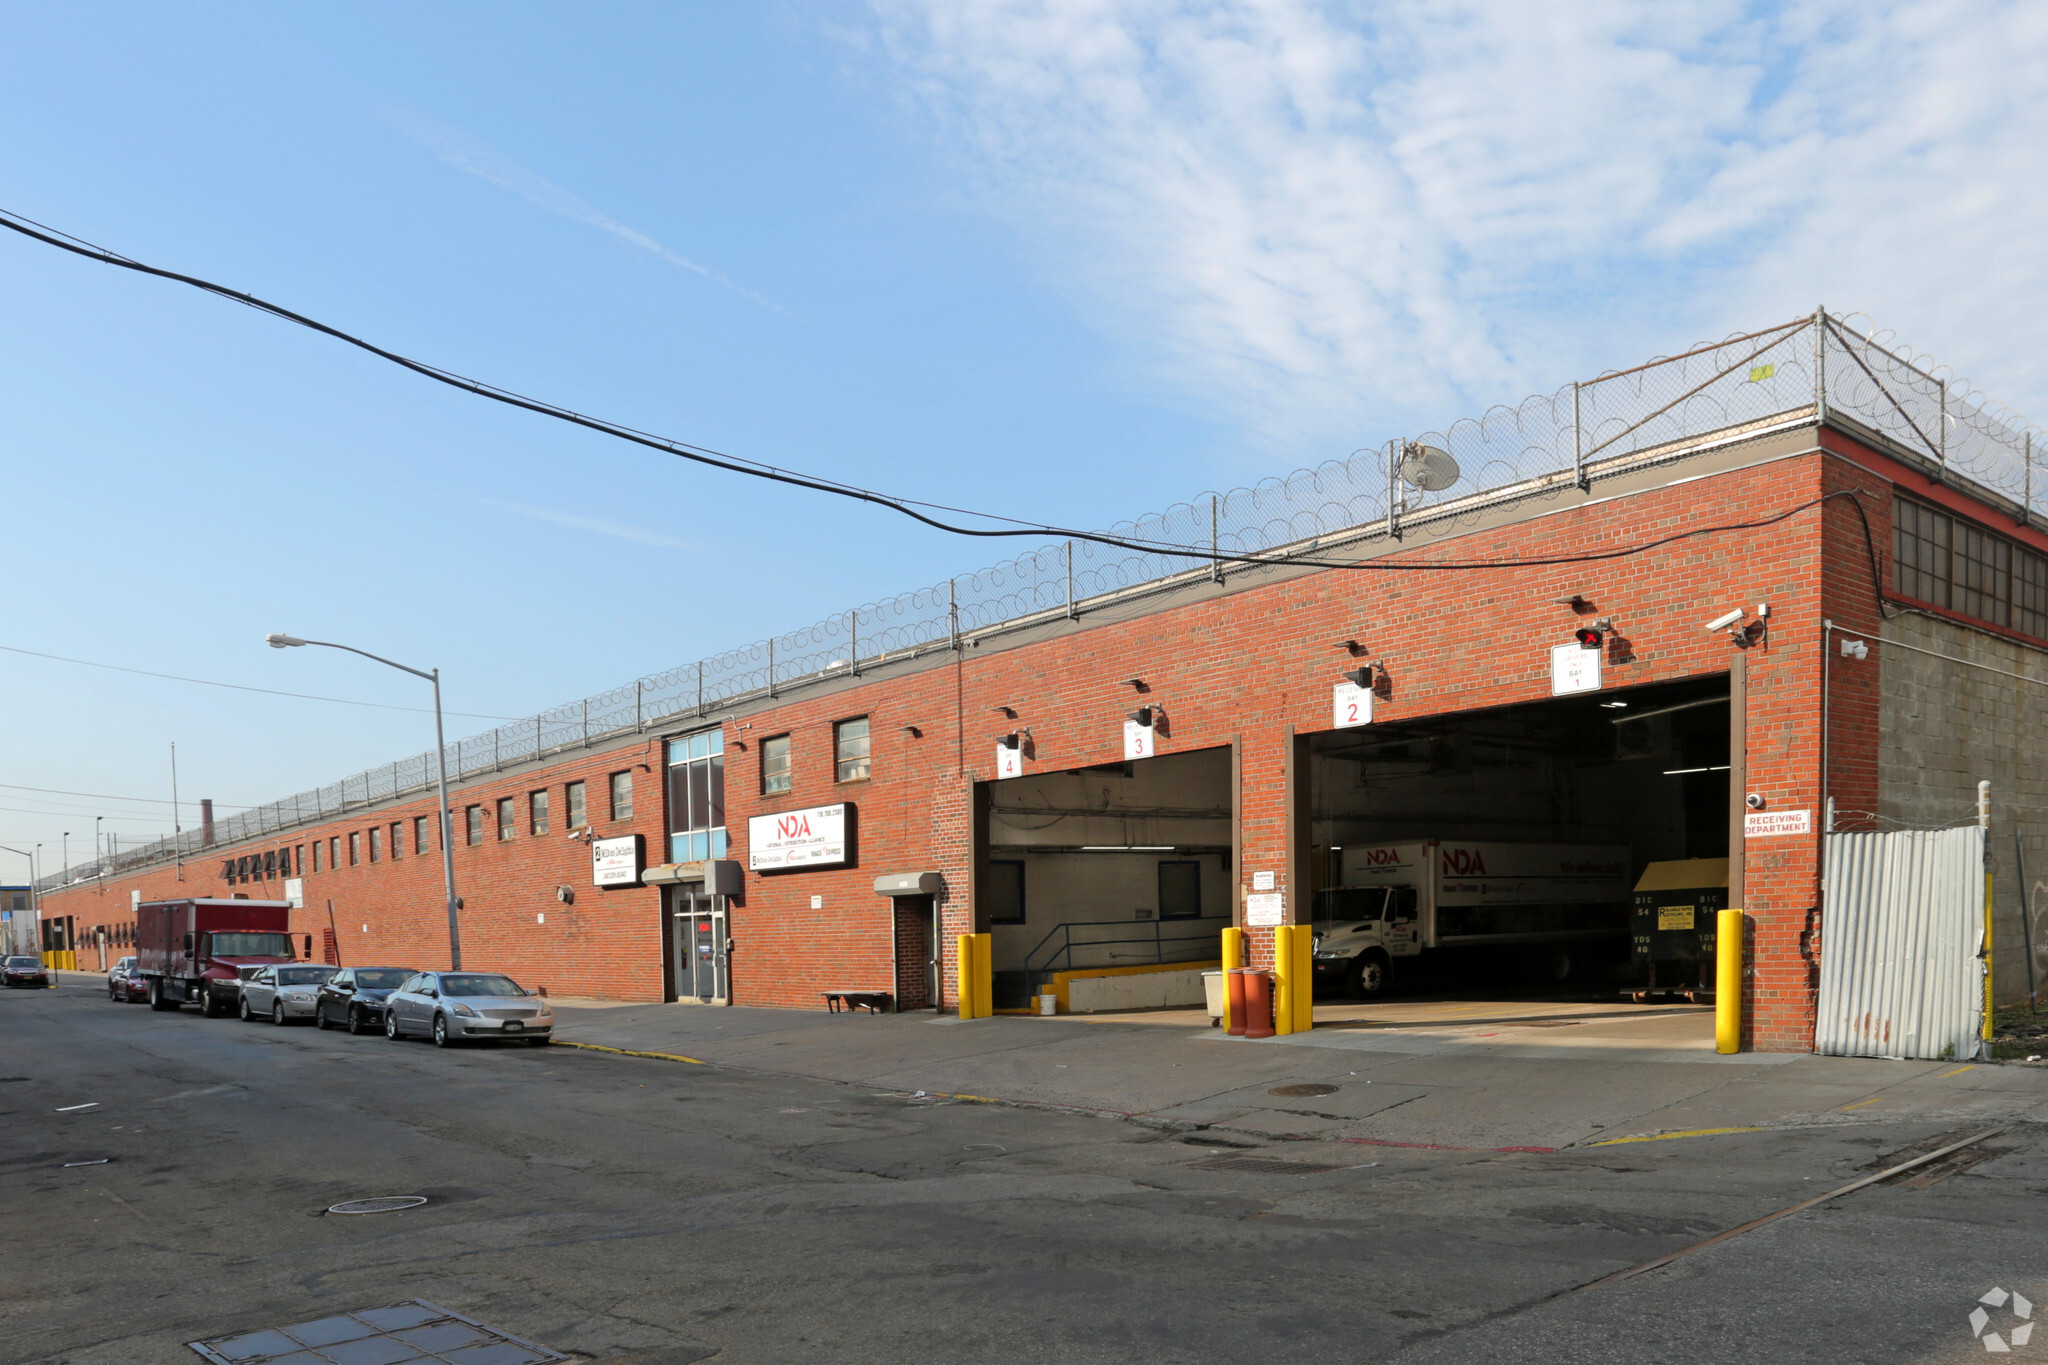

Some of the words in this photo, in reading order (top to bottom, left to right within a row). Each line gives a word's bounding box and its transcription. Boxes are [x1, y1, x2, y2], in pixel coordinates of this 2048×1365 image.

[1569, 669, 1583, 677] BAY
[1576, 678, 1580, 687] 1
[1347, 704, 1358, 722] 2
[1134, 738, 1143, 754] 3
[1006, 759, 1013, 773] 4
[1750, 814, 1802, 825] RECEIVING
[778, 814, 811, 840] NDA
[1745, 822, 1806, 834] DEPARTMENT
[1367, 848, 1401, 866] NDA
[1442, 848, 1487, 875] NDA
[1702, 944, 1713, 952] 40
